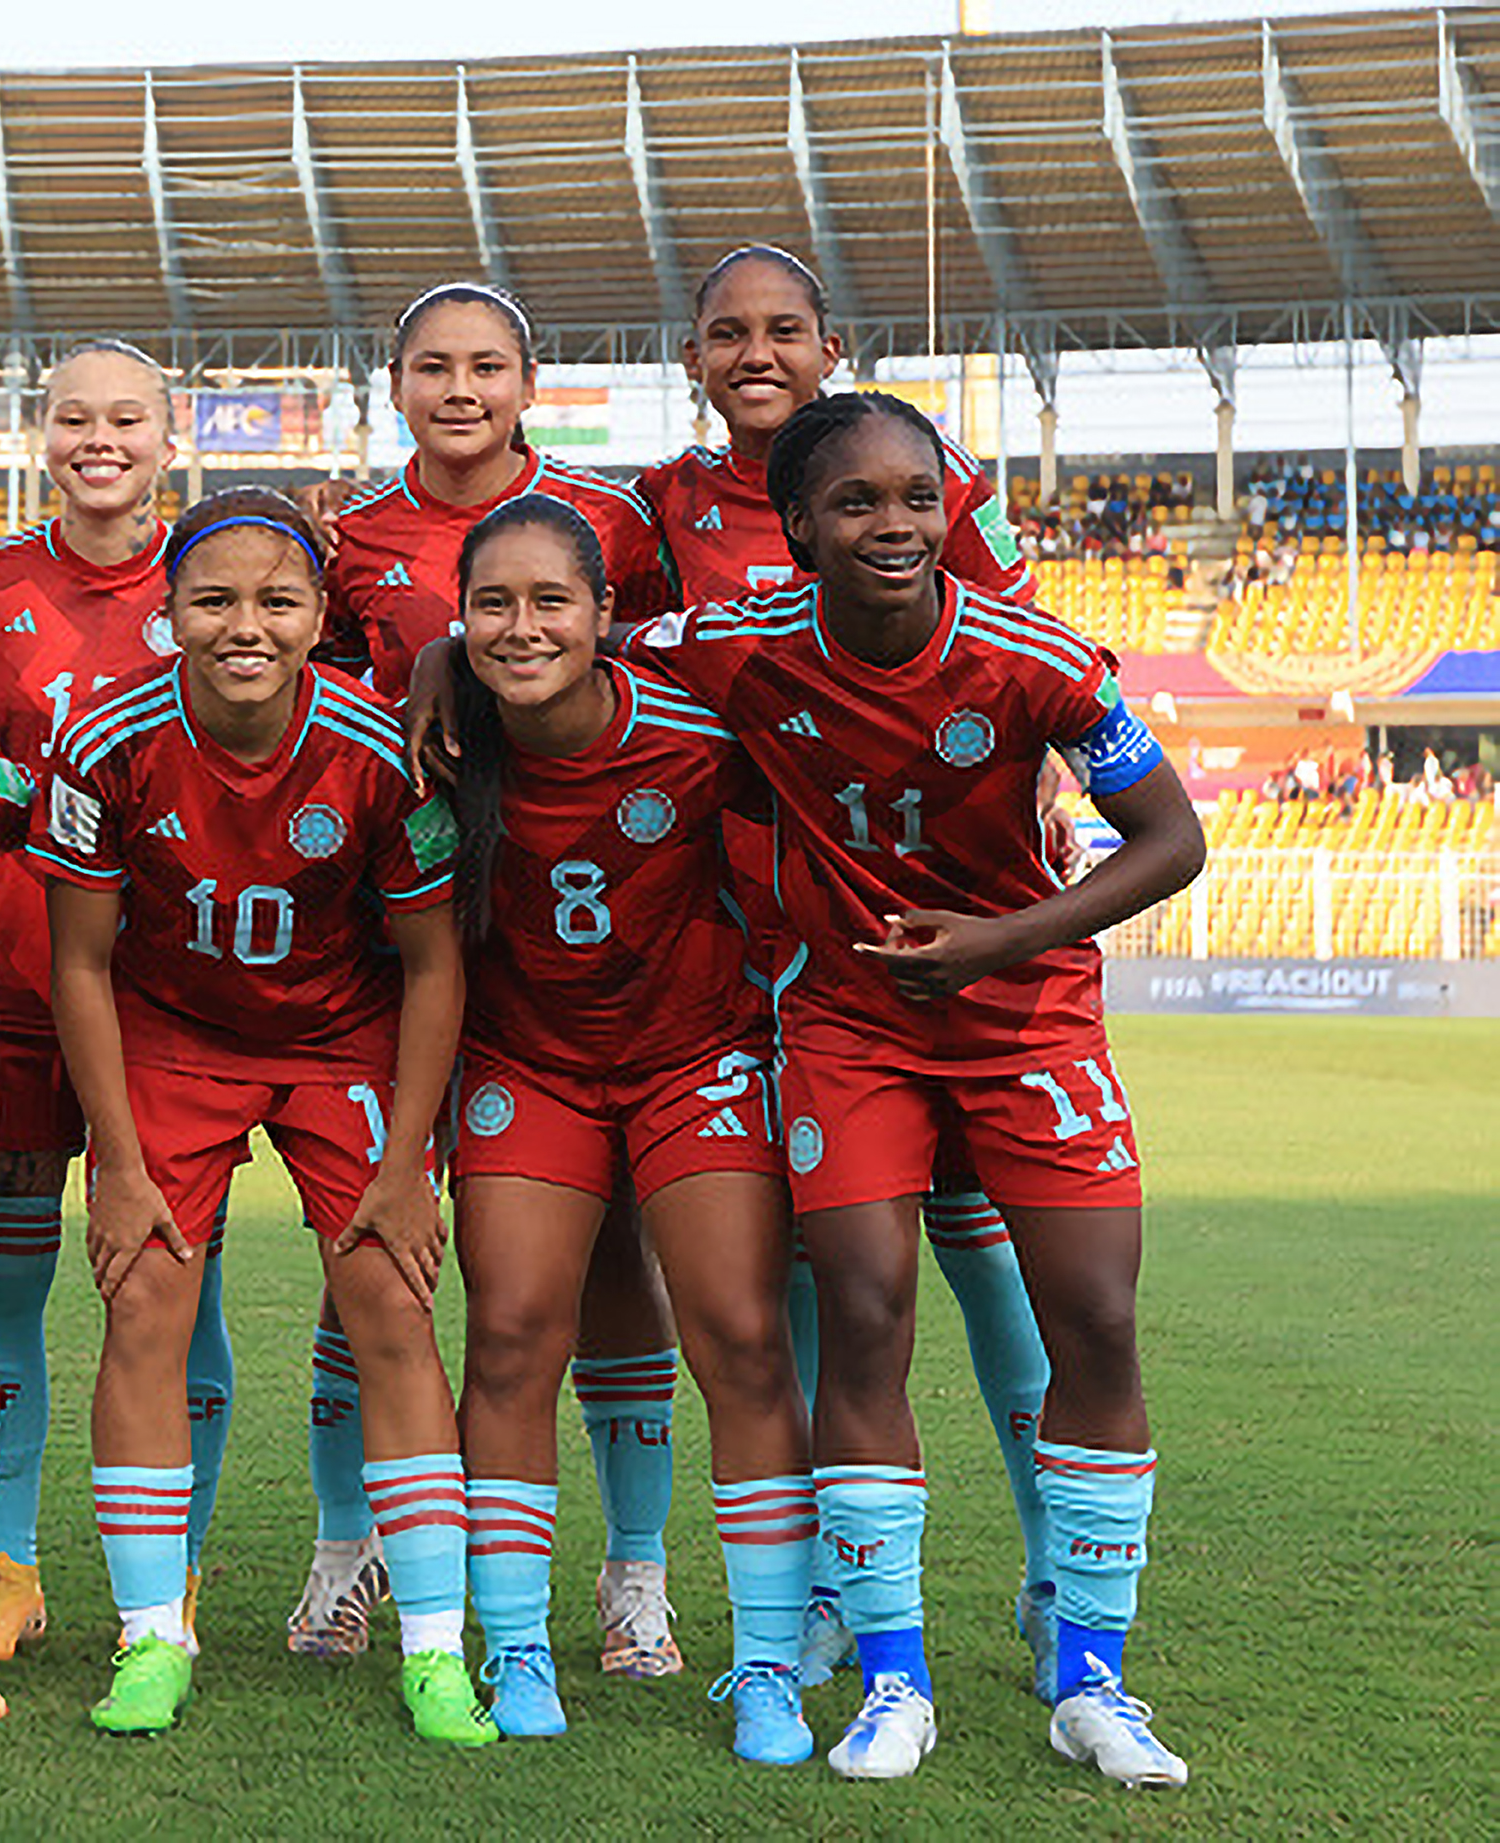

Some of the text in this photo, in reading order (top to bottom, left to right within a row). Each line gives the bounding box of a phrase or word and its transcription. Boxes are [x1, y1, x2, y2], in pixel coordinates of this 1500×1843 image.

[833, 782, 934, 858] 11
[185, 878, 294, 965] 10
[550, 859, 611, 944] 8
[1020, 1057, 1128, 1140] 11
